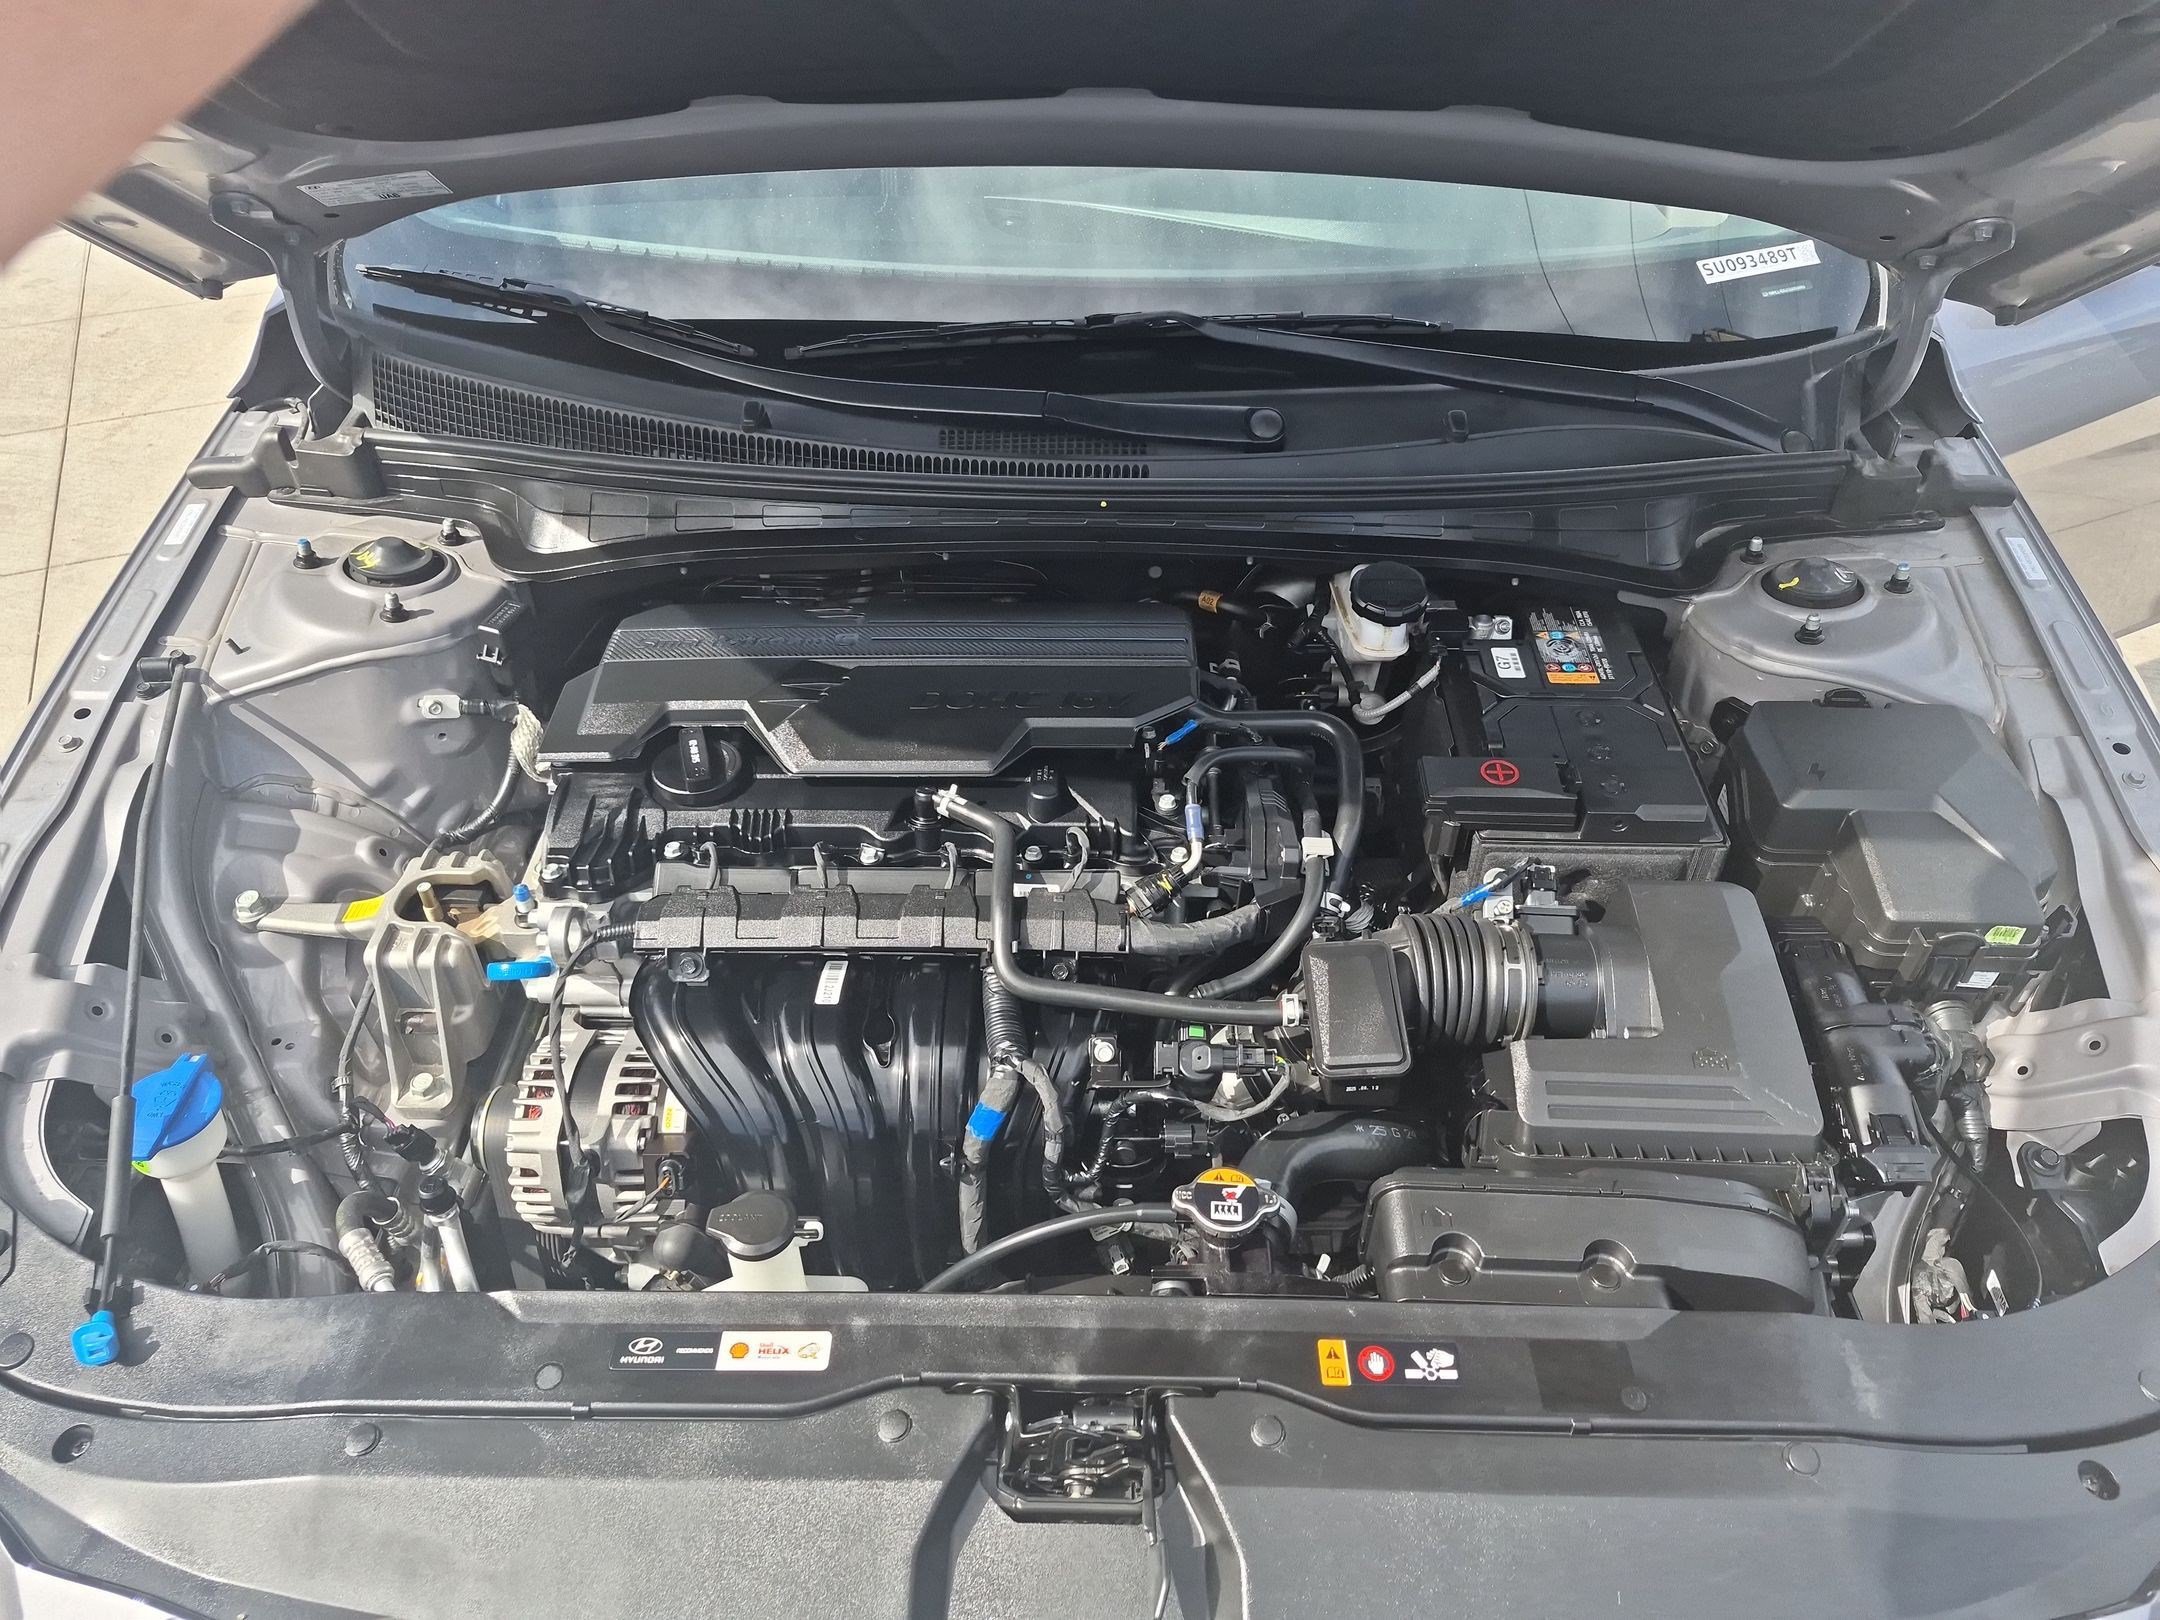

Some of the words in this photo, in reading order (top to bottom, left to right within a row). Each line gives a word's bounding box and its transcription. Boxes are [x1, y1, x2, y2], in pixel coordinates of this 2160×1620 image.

[1702, 247, 1798, 276] SU093489T
[1497, 655, 1511, 669] G7
[1391, 1127, 1401, 1138] G
[758, 1347, 790, 1355] HELIX
[619, 1355, 665, 1364] HYUNDAI
